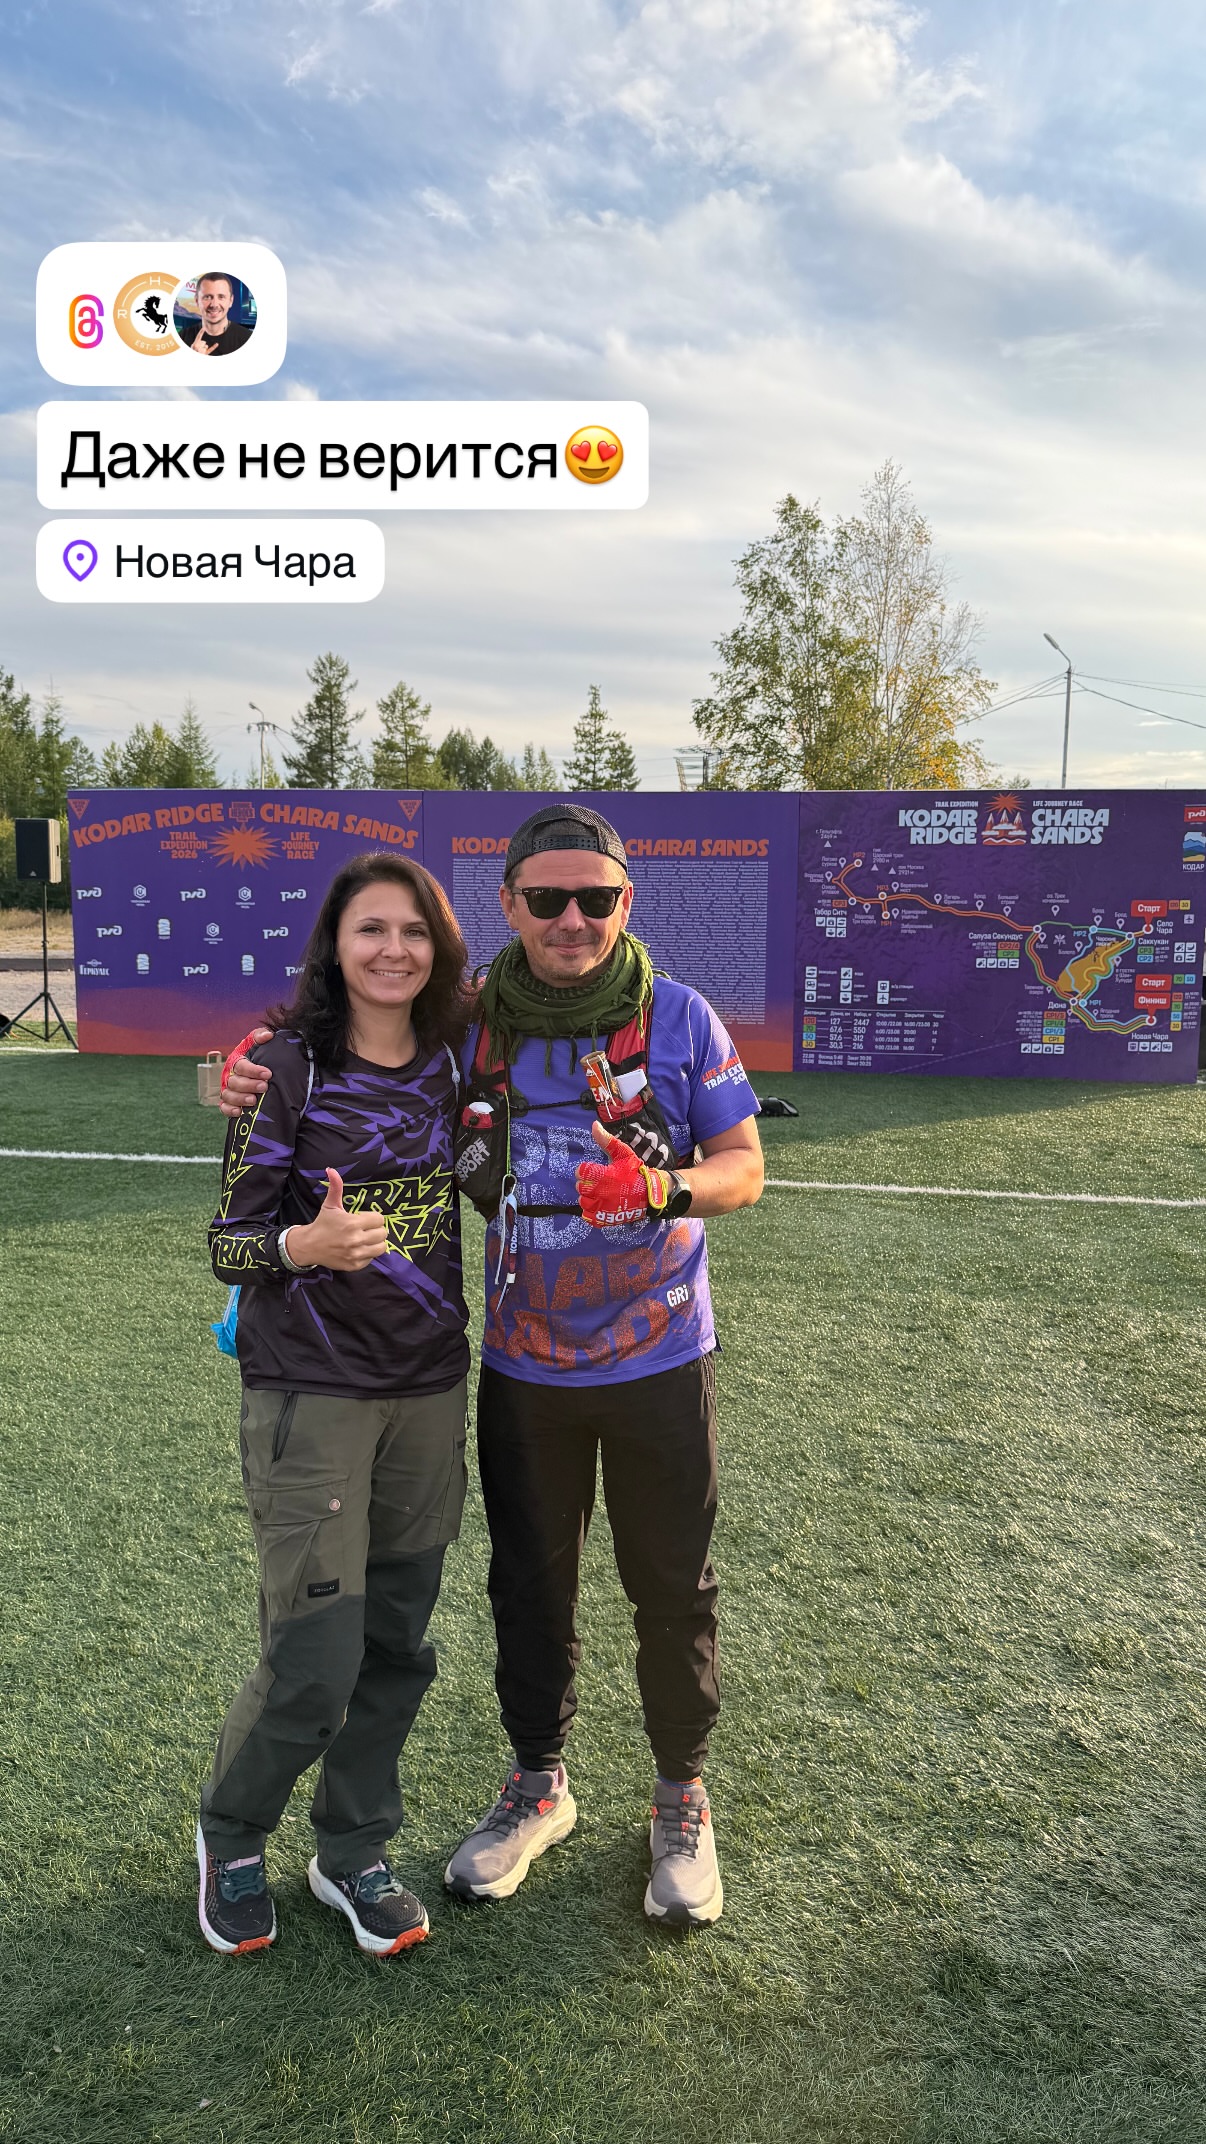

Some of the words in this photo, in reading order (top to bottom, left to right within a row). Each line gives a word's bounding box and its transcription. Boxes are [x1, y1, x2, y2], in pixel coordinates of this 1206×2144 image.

[899, 809, 978, 827] KODAR
[1032, 808, 1110, 827] CHARA
[73, 812, 152, 848] KODAR
[154, 803, 224, 828] RIDGE
[260, 803, 340, 830] CHARA
[342, 814, 419, 849] SANDS
[169, 831, 198, 841] TRAIL
[290, 832, 310, 841] LIFE
[910, 827, 977, 845] RIDGE
[1030, 827, 1103, 845] SANDS
[160, 840, 208, 850] EXPEDITION
[281, 841, 320, 851] JOURNEY
[452, 837, 511, 854] KODA
[625, 839, 697, 856] CHARA
[700, 839, 769, 857] SANDS
[171, 850, 198, 859] 2026
[287, 851, 315, 860] RACE
[1182, 863, 1205, 871] КОДАР
[1137, 904, 1161, 913] Старт
[1142, 978, 1165, 987] Старт
[1138, 996, 1167, 1005] Финиш
[1048, 1002, 1067, 1010] Дюна
[1153, 1033, 1168, 1041] Чара
[703, 1072, 728, 1090] TRAIL
